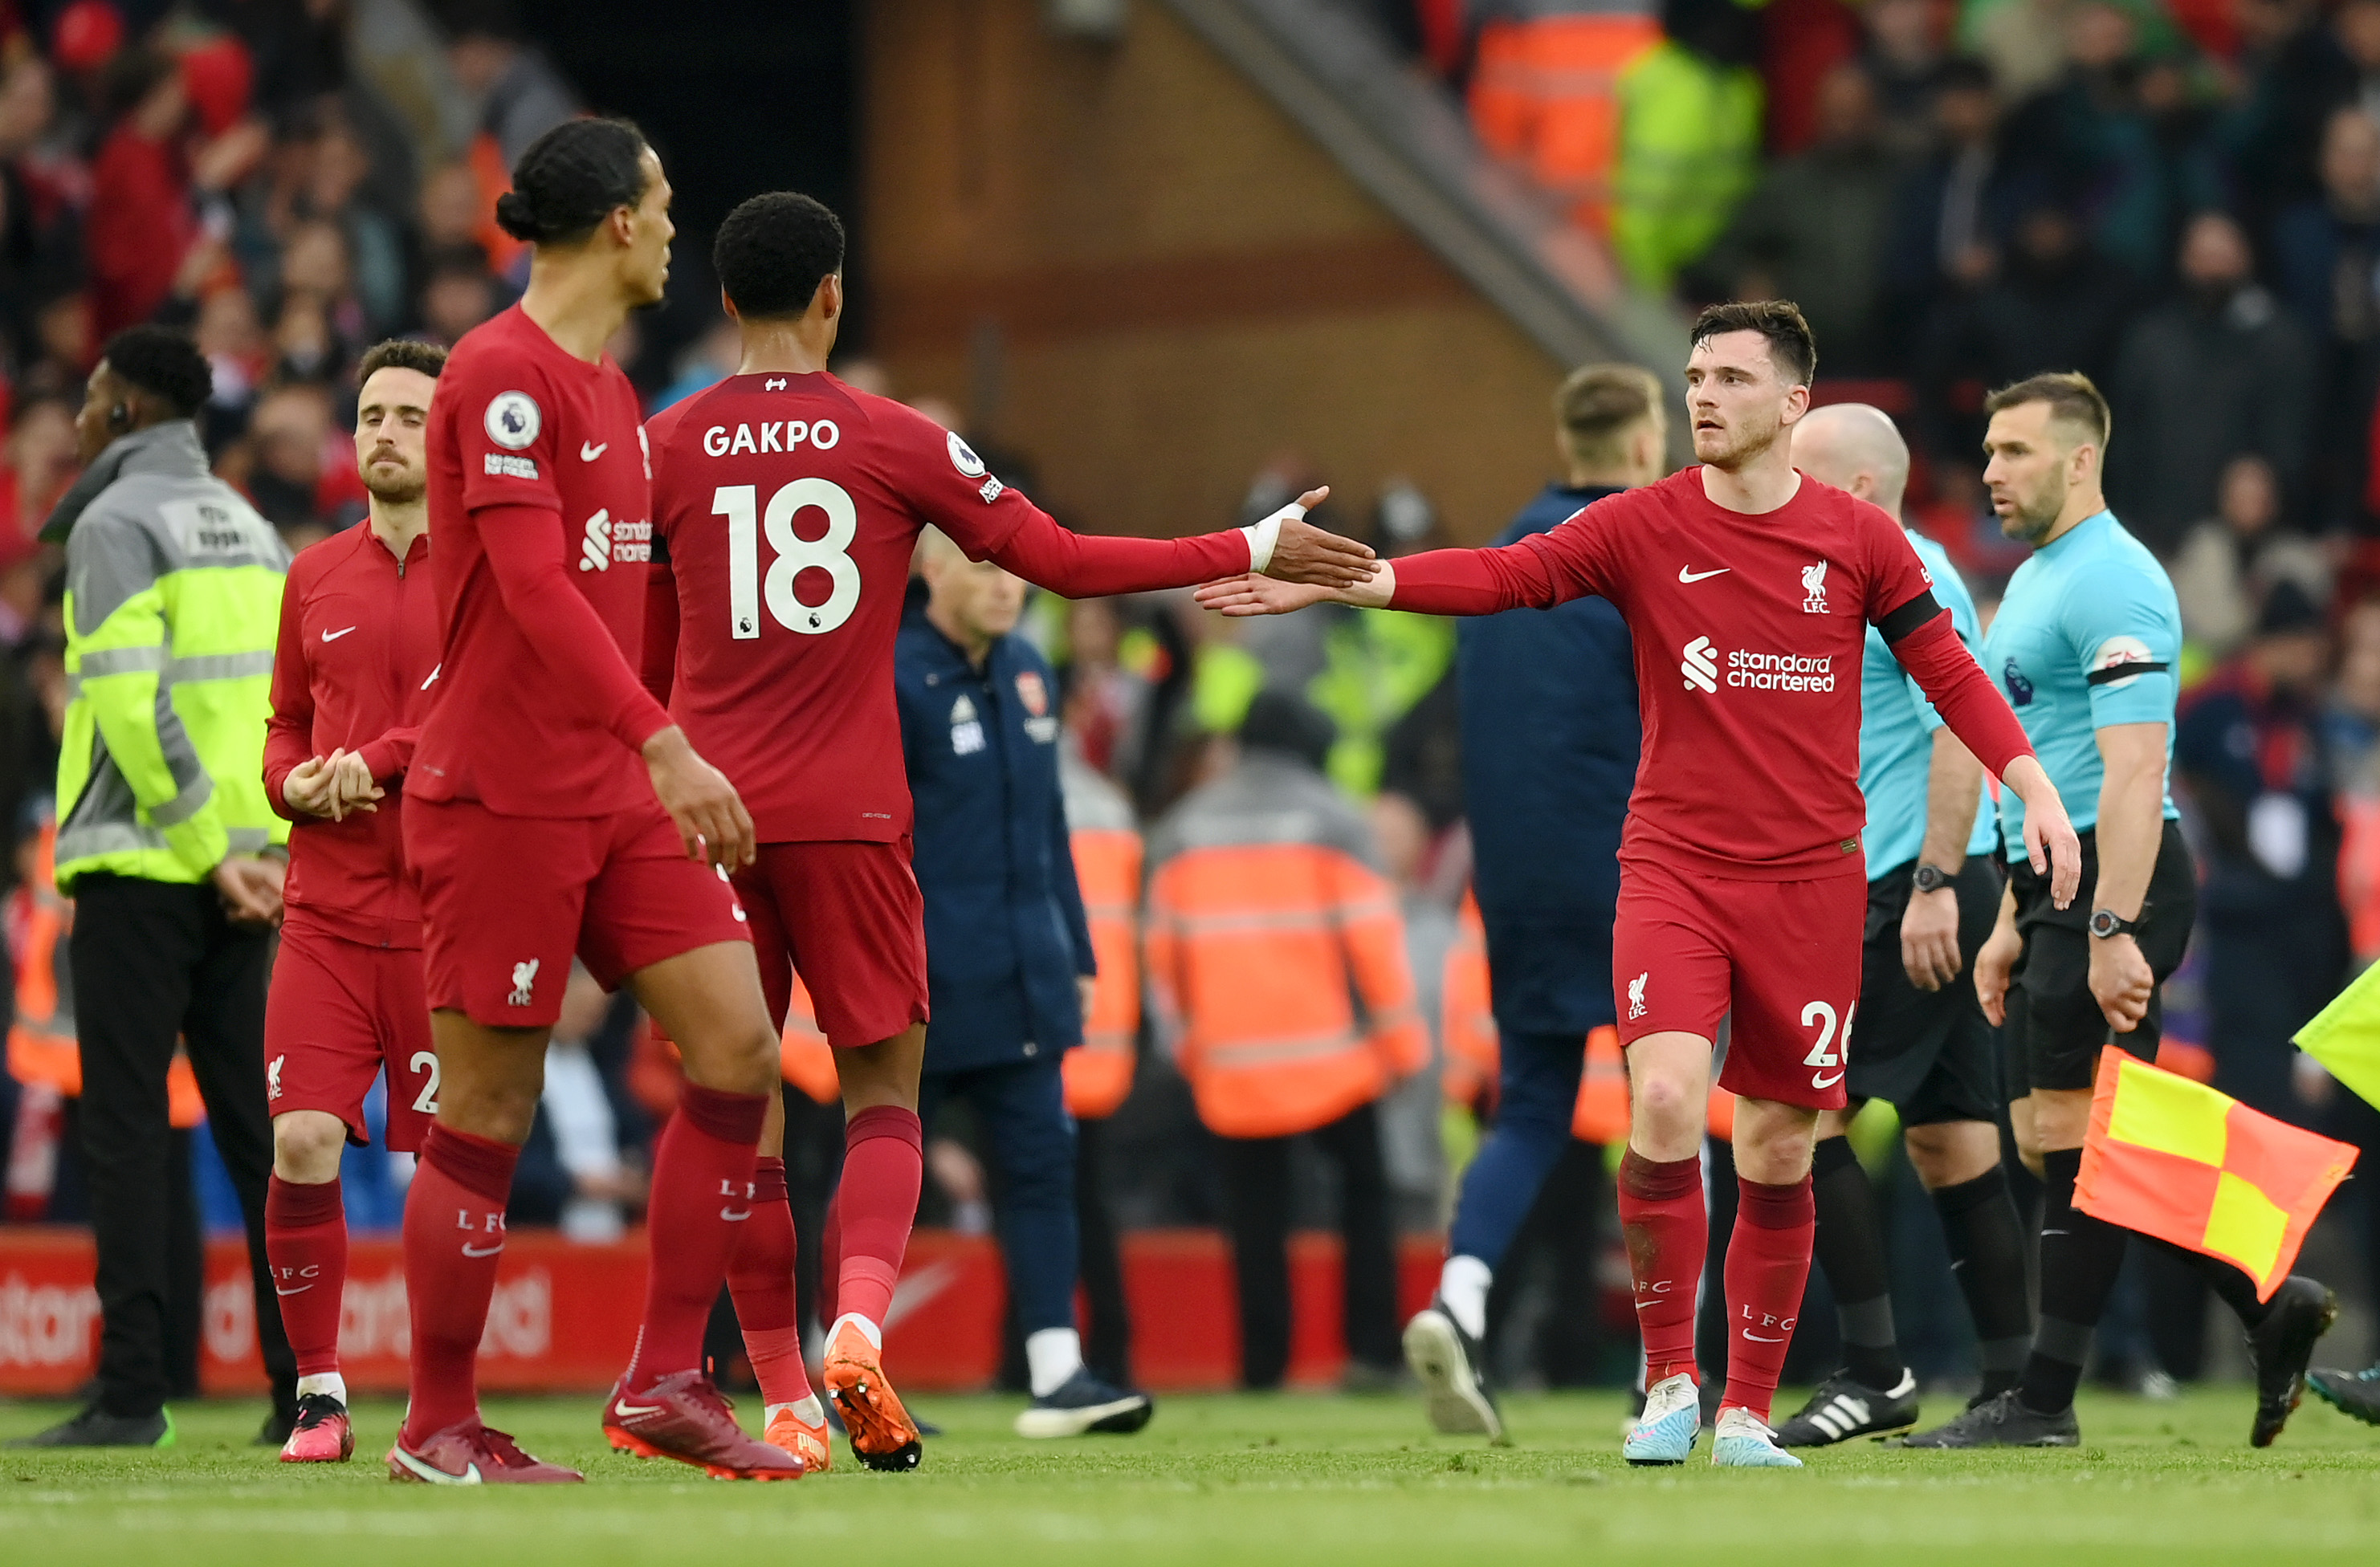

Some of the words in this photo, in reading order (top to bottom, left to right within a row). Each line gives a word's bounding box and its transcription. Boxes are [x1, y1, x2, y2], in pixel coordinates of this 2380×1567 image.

[703, 419, 840, 457] GAKPO
[711, 477, 862, 640] 18
[1727, 649, 1832, 674] standard
[1727, 668, 1835, 693] chartered
